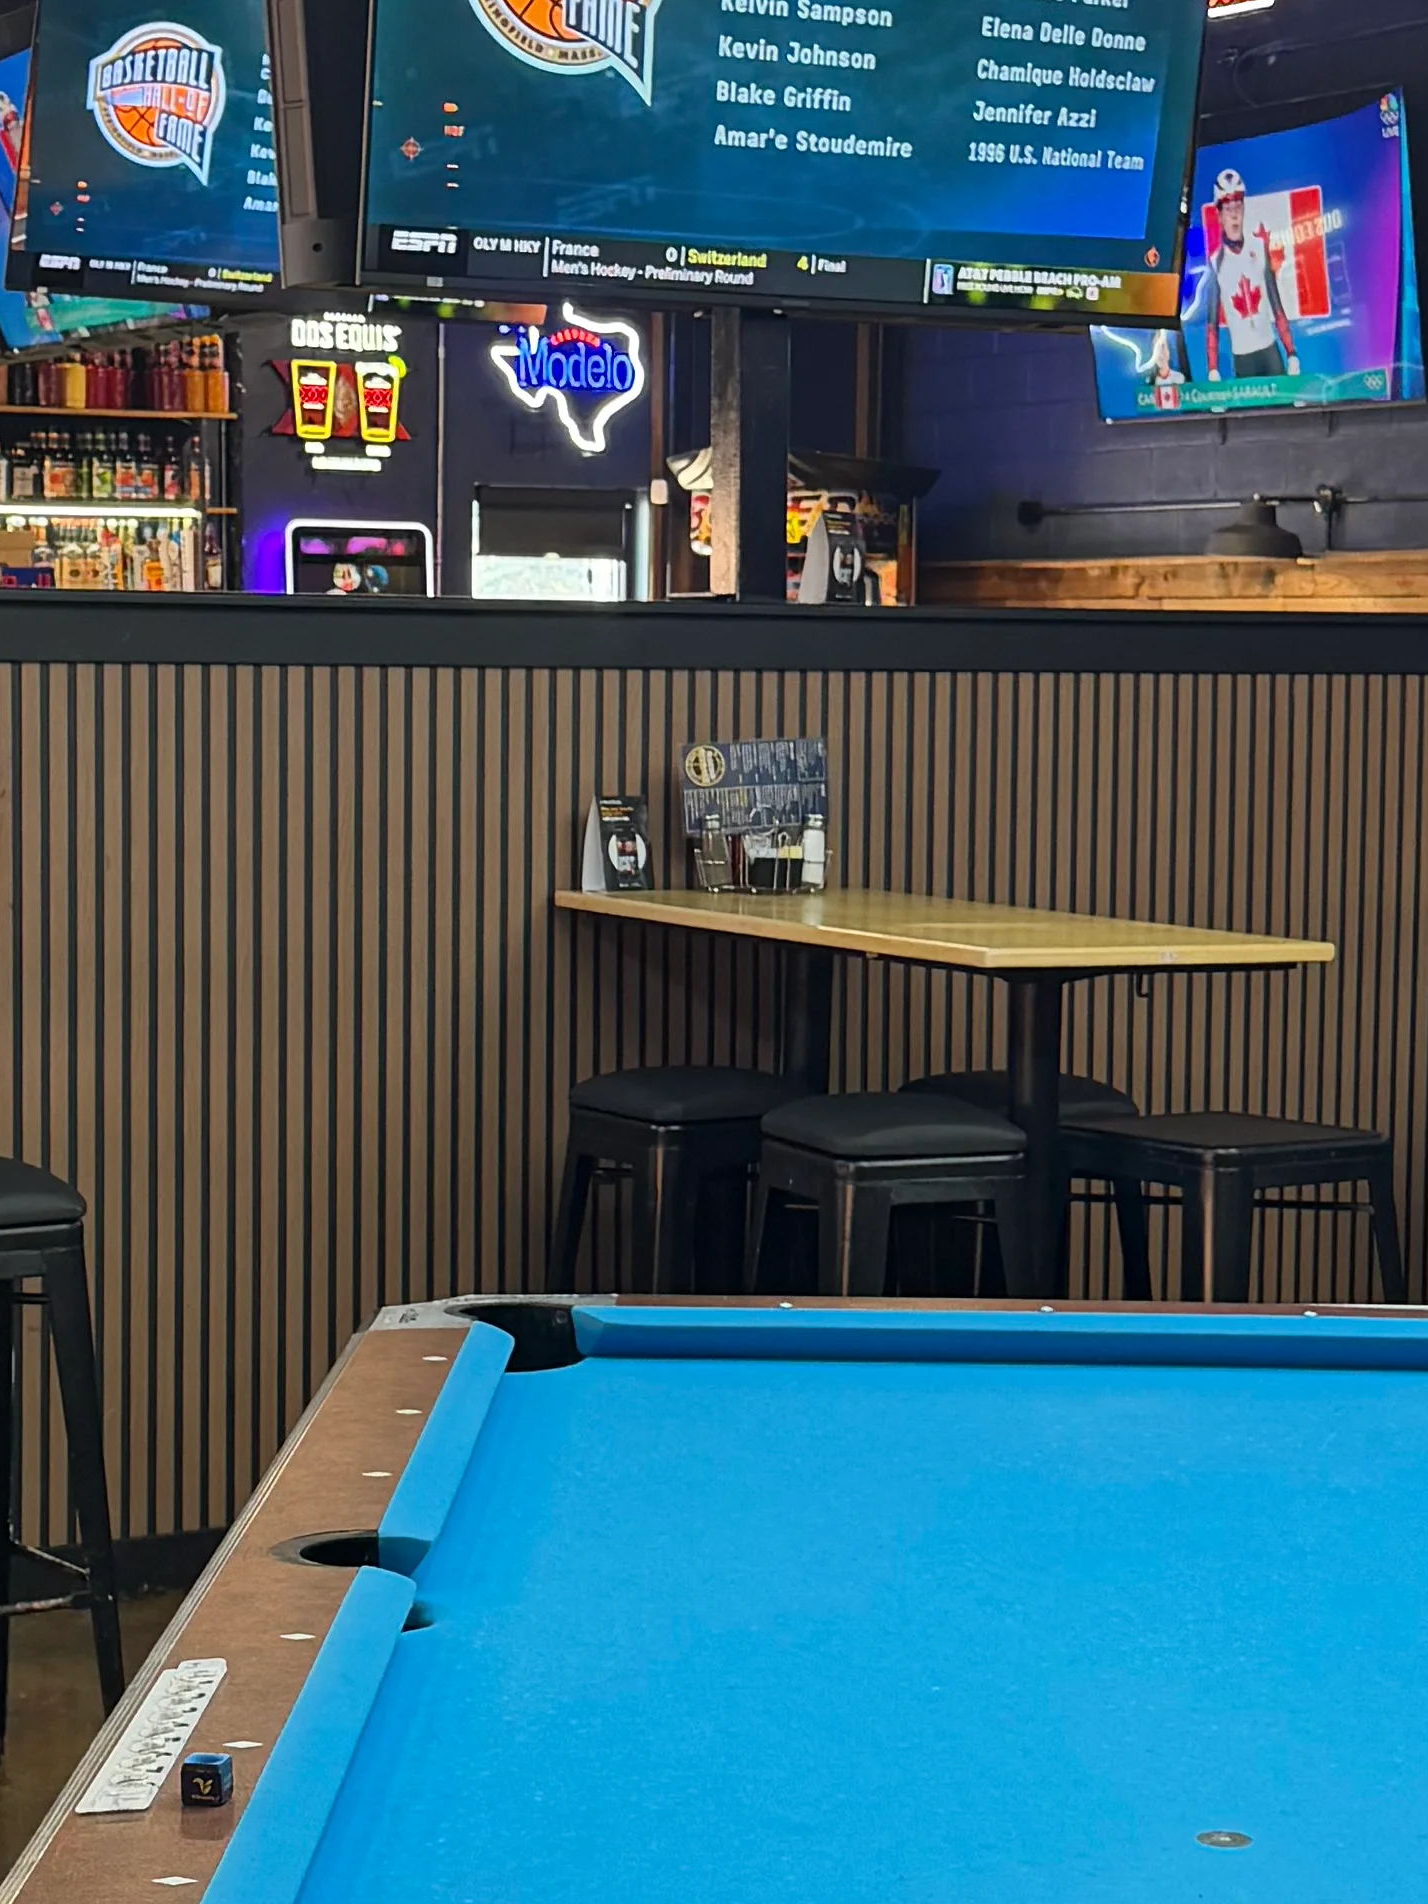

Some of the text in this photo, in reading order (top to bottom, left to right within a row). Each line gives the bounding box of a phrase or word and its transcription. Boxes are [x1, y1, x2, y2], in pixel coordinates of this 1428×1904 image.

[982, 16, 1146, 51] Elena Delle Donne
[718, 35, 876, 70] Kevin Johnson
[102, 48, 210, 90] BASKETBALL
[977, 59, 1156, 93] Chamique Holdsclaw
[716, 80, 851, 111] Blake Griffin
[973, 100, 1097, 128] Jennifer Azzi
[158, 112, 204, 164] FAME
[714, 125, 912, 158] Amar'e Stoudemire
[968, 142, 1144, 170] 1996 U.S. National Team
[391, 229, 458, 254] ESPN
[552, 239, 678, 263] France 0
[551, 257, 588, 276] Men's
[590, 262, 636, 282] Hockey
[645, 267, 712, 286] Preliminary
[714, 269, 754, 286] Round
[687, 248, 810, 271] Switzerland 4
[291, 317, 334, 349] DOS
[517, 334, 636, 392] Modelo
